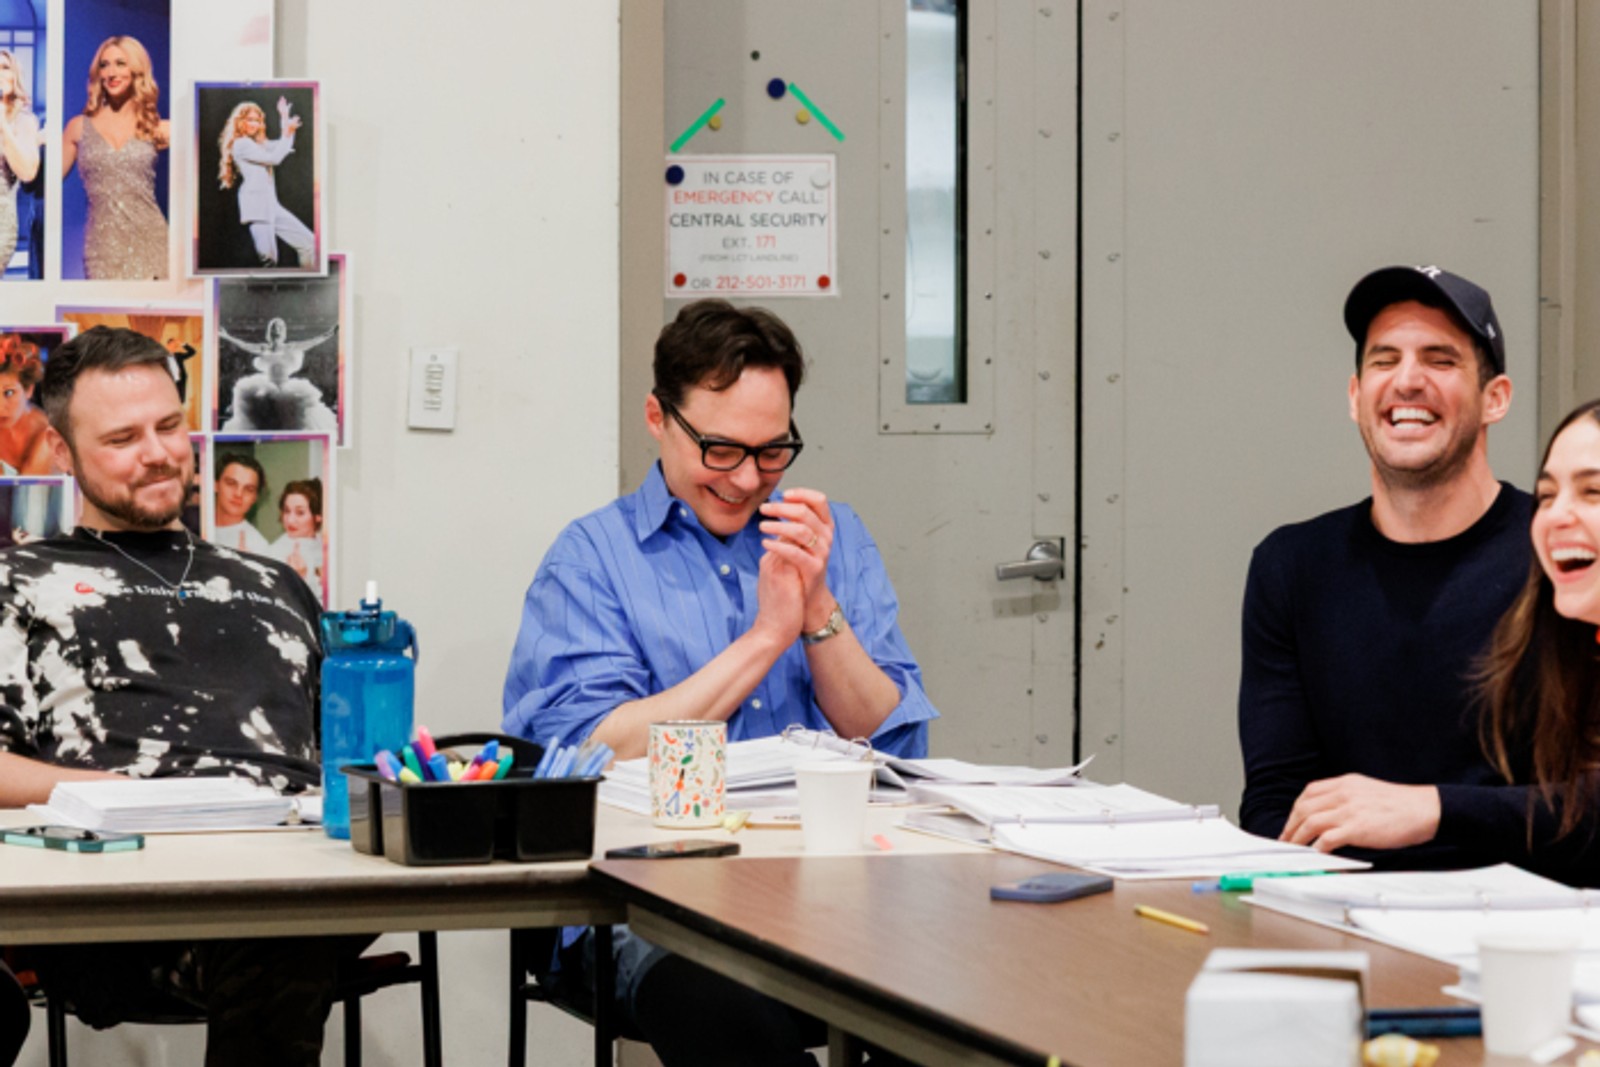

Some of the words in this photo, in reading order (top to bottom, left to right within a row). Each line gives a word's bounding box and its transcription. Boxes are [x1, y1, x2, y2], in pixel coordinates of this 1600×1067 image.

[703, 171, 719, 184] IN
[725, 171, 767, 184] CASE
[772, 171, 794, 184] OF
[673, 191, 774, 204] EMERGENCY
[669, 213, 745, 227] CENTRAL
[750, 213, 827, 227] SECURITY
[722, 236, 750, 249] EXT.
[755, 235, 776, 248] 171
[690, 278, 711, 289] OR
[716, 275, 806, 289] 212-501-3171
